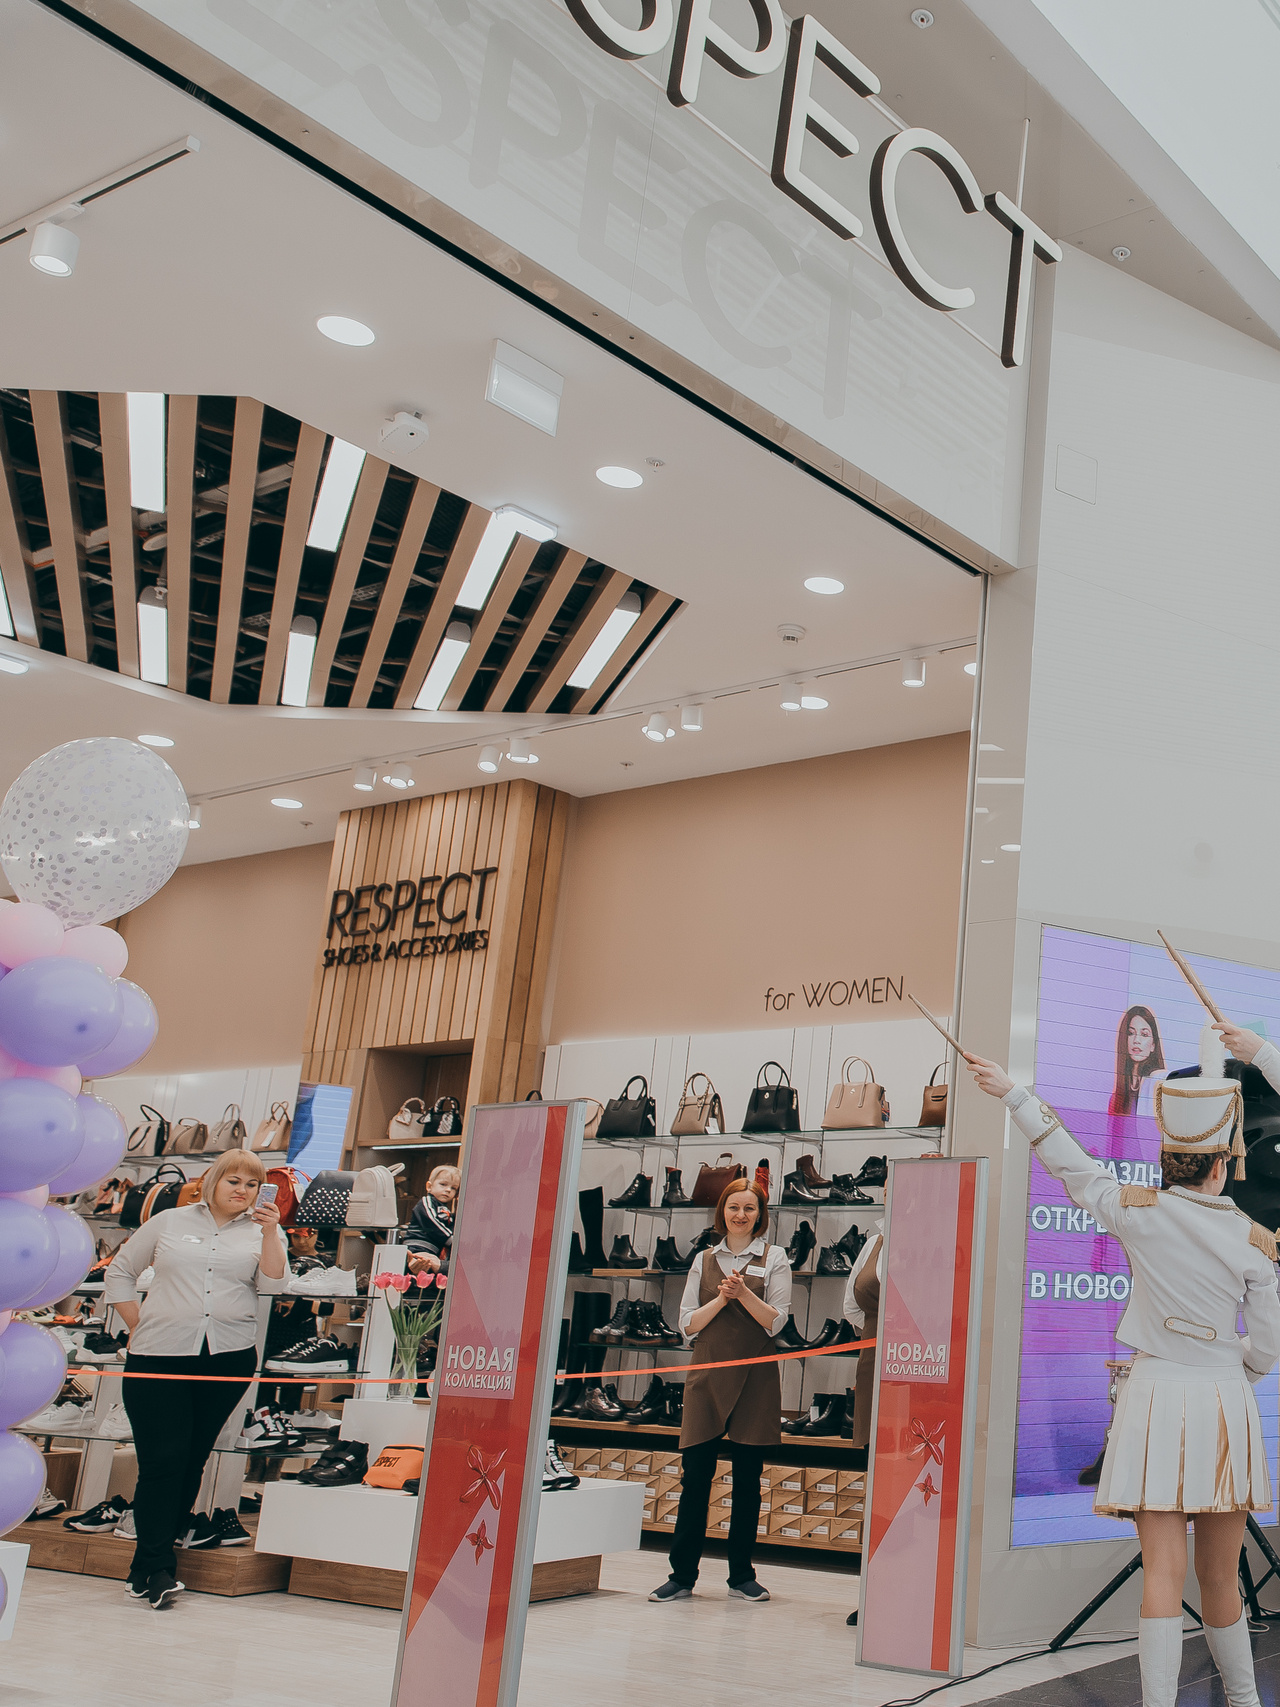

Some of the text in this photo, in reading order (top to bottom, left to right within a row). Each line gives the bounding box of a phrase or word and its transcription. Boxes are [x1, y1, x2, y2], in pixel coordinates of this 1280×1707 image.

[326, 866, 498, 939] RESPECT
[384, 929, 489, 960] ACCESSORIES
[764, 975, 904, 1012] for WOMEN
[1031, 1272, 1134, 1300] В НОВО
[447, 1345, 515, 1373] НОВАЯ
[886, 1342, 947, 1363] НОВАЯ
[444, 1372, 512, 1392] КОЛЛЕКЦИЯ
[885, 1362, 946, 1378] КОЛЛЕКЦИЯ
